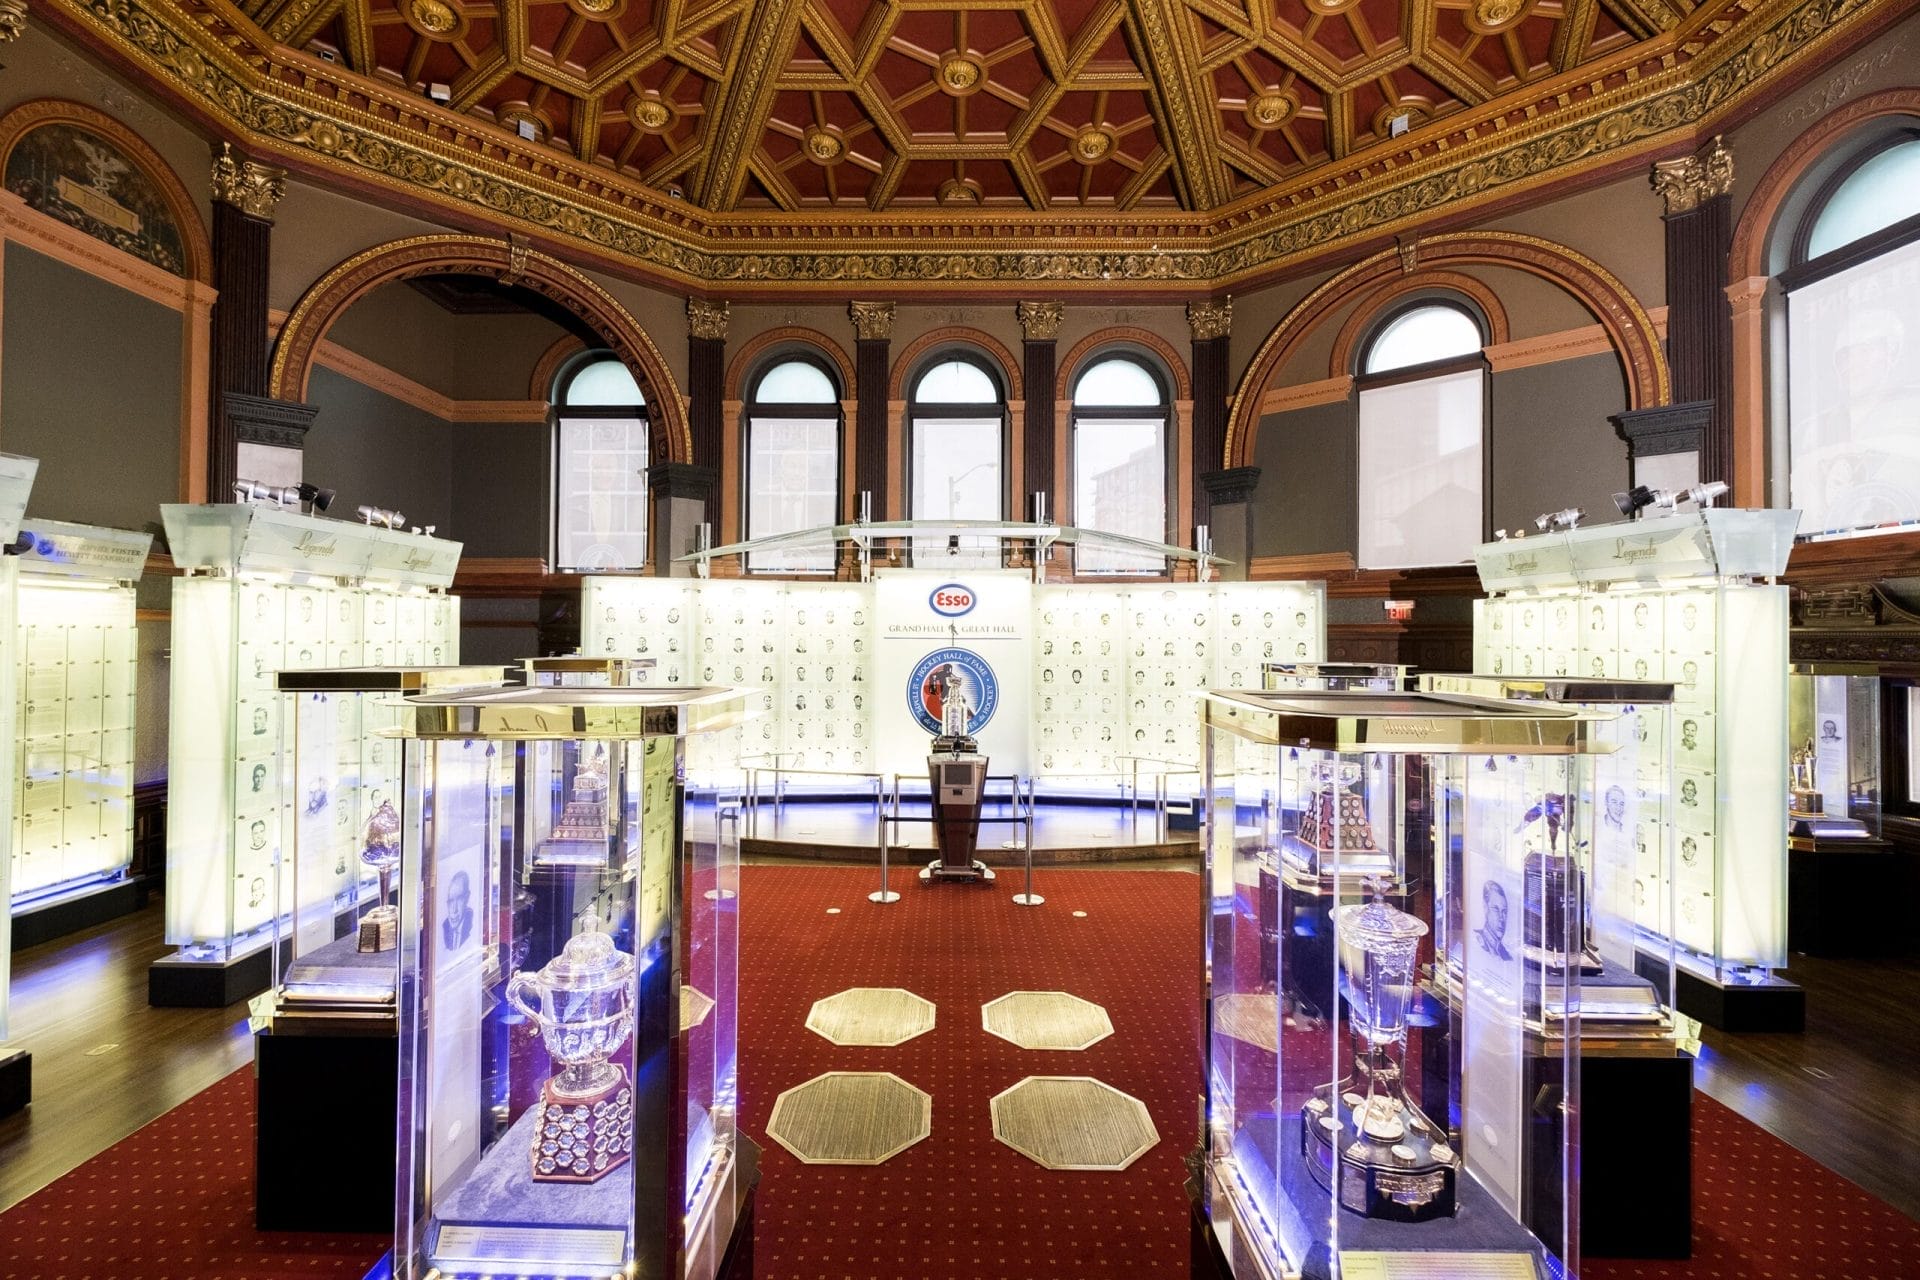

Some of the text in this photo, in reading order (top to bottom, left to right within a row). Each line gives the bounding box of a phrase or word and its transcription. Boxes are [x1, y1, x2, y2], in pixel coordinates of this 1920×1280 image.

[1612, 536, 1657, 564] Legends
[889, 625, 945, 633] GRAND HALL
[961, 625, 1016, 633] GREAT HALL
[917, 656, 942, 677] HOCKEY
[944, 652, 963, 661] HALL
[971, 659, 988, 676] FAME
[982, 684, 993, 714] HOCKEY
